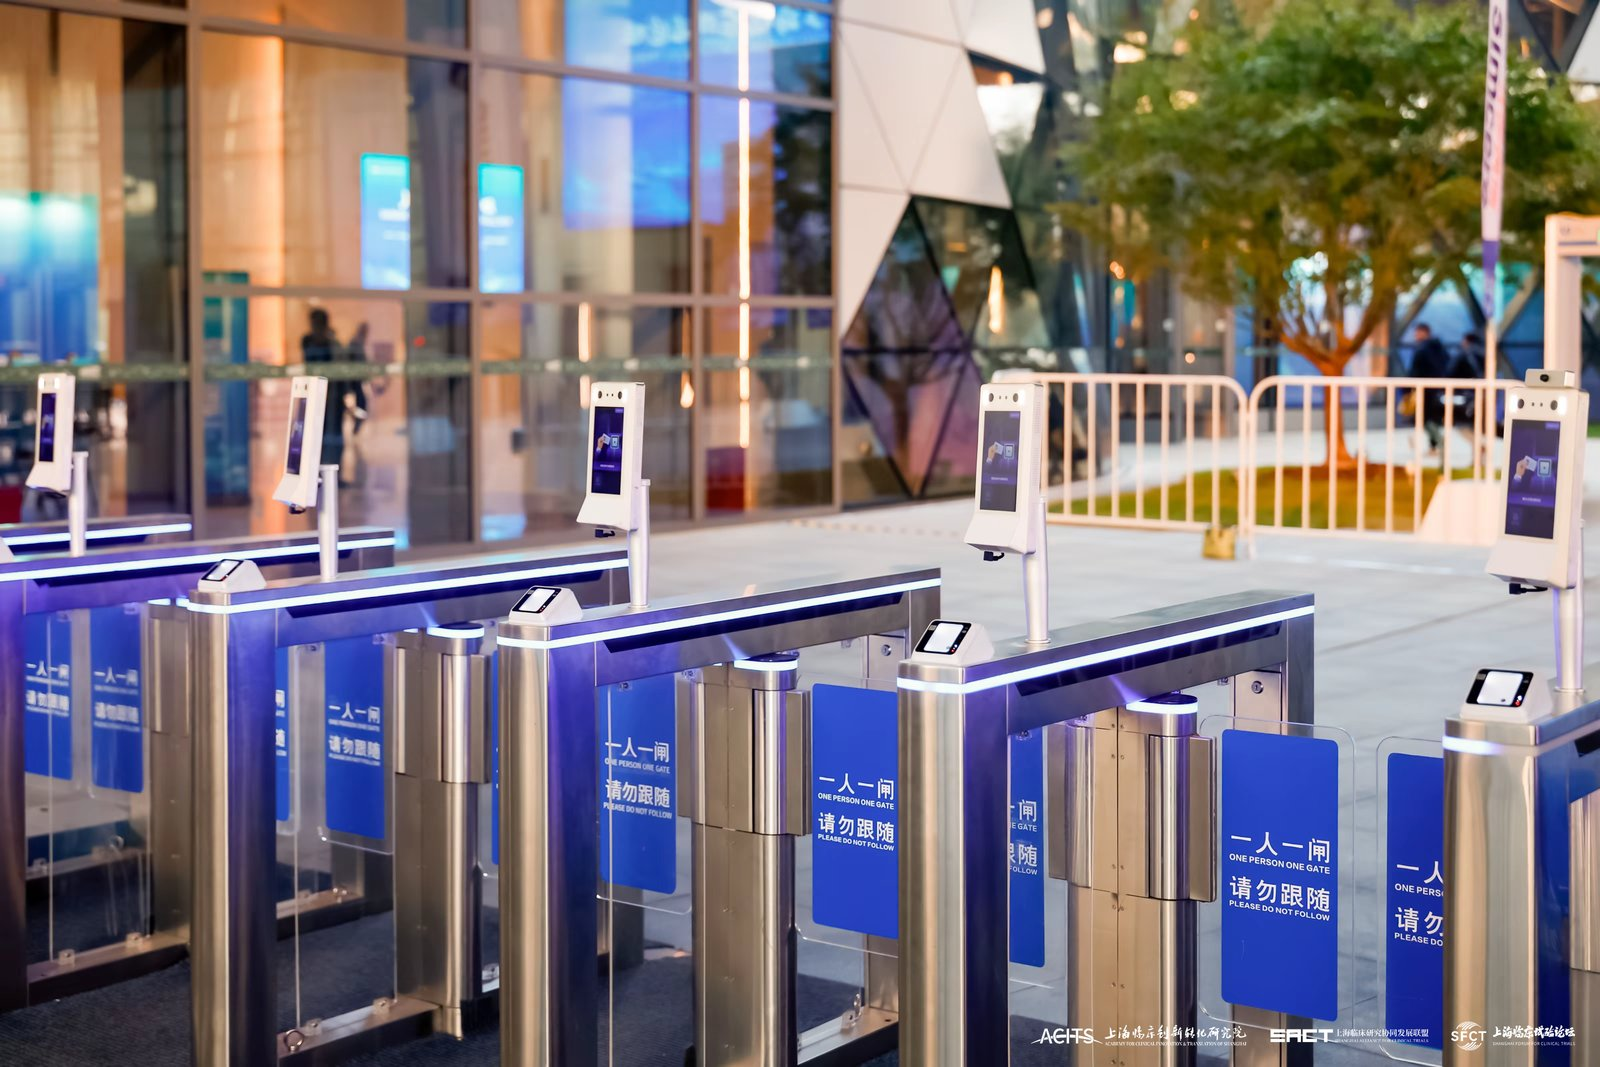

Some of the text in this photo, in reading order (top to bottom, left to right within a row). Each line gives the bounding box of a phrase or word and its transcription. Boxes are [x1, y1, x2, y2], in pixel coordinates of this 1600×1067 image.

[328, 702, 380, 724] 一人一闸
[605, 737, 669, 763] 一人一闸
[619, 760, 642, 769] PERSON
[642, 763, 654, 772] ONE
[655, 765, 670, 774] GATE
[605, 779, 670, 808] 请勿跟随
[819, 773, 894, 800] 一人一闸
[833, 795, 859, 805] PERSON
[861, 799, 875, 807] ONE
[876, 801, 894, 810] GATE
[648, 809, 672, 819] FOLLOW
[818, 812, 894, 843] 请勿跟随
[1018, 823, 1037, 832] GATE
[818, 834, 841, 843] PLEASE
[868, 842, 894, 851] FOLLOW
[1231, 832, 1330, 863] 一人一闸
[1229, 853, 1330, 874] ONE PERSON ONE GATE
[1230, 876, 1330, 912] 请勿跟随
[1395, 883, 1444, 897] ONE PERS
[1229, 900, 1260, 910] PLEASE
[1276, 907, 1293, 915] NOT
[1295, 910, 1330, 921] FOLLOW
[1394, 932, 1428, 944] PLEASE
